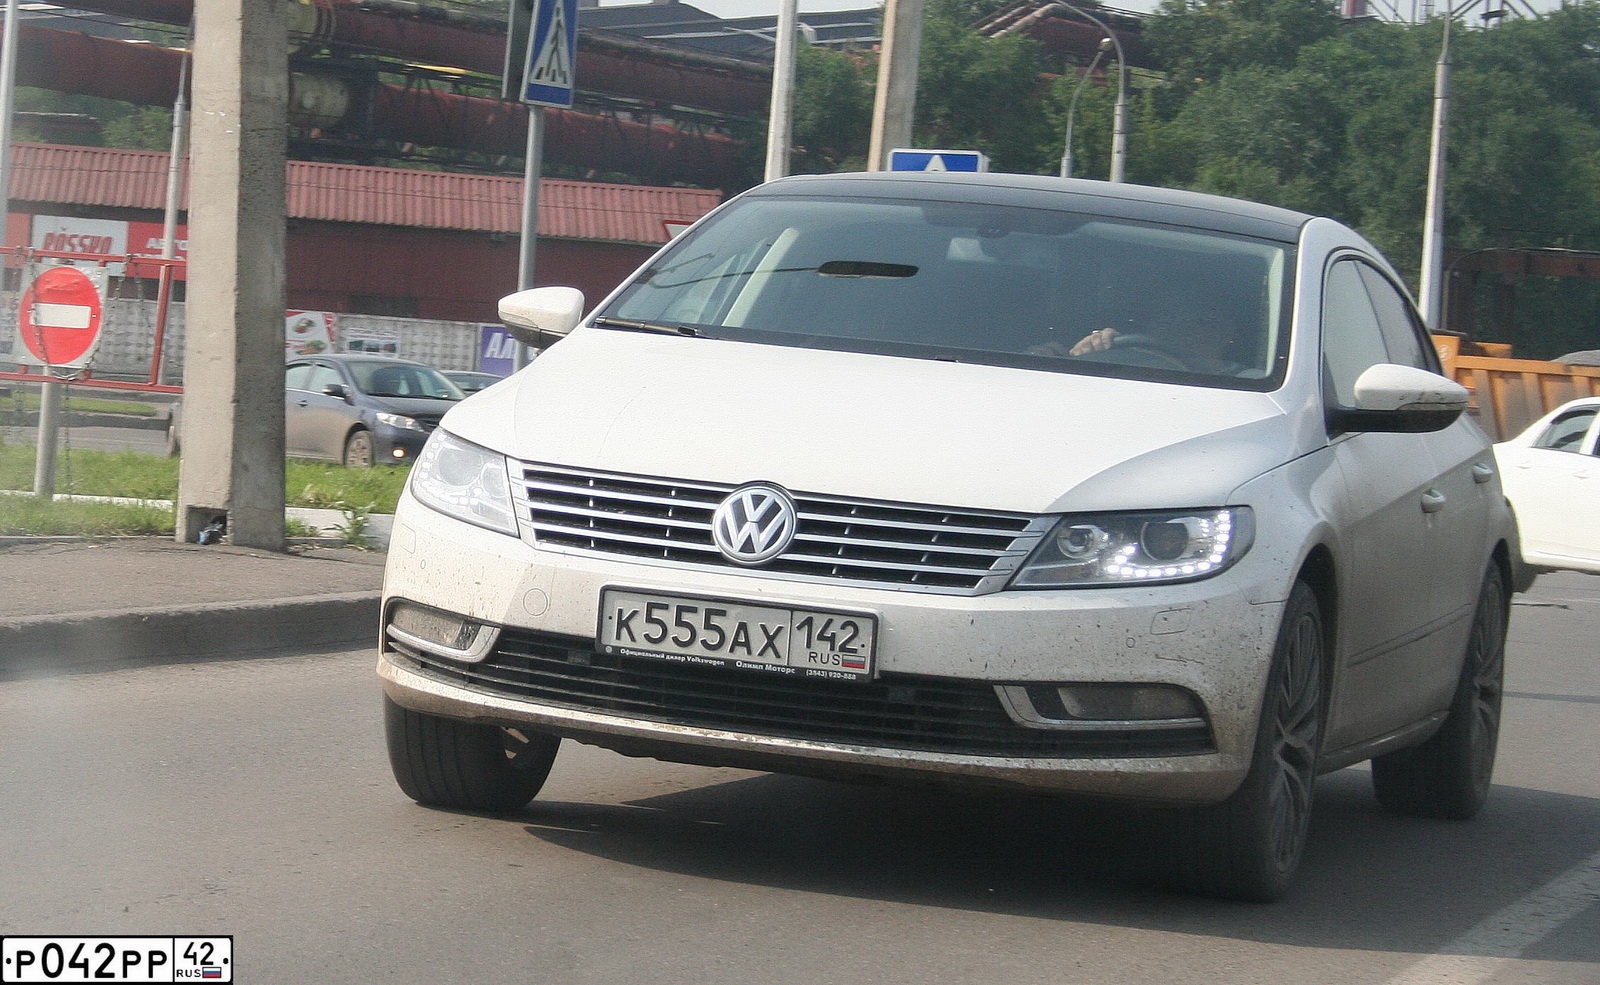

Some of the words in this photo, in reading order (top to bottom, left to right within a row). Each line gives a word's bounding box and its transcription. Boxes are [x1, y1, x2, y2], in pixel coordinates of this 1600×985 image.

[615, 601, 785, 659] K555AX
[796, 615, 859, 654] 142
[686, 656, 725, 666] Volkswagen
[808, 651, 841, 665] RUS
[735, 660, 764, 670] Олимп
[764, 664, 796, 674] Моторс
